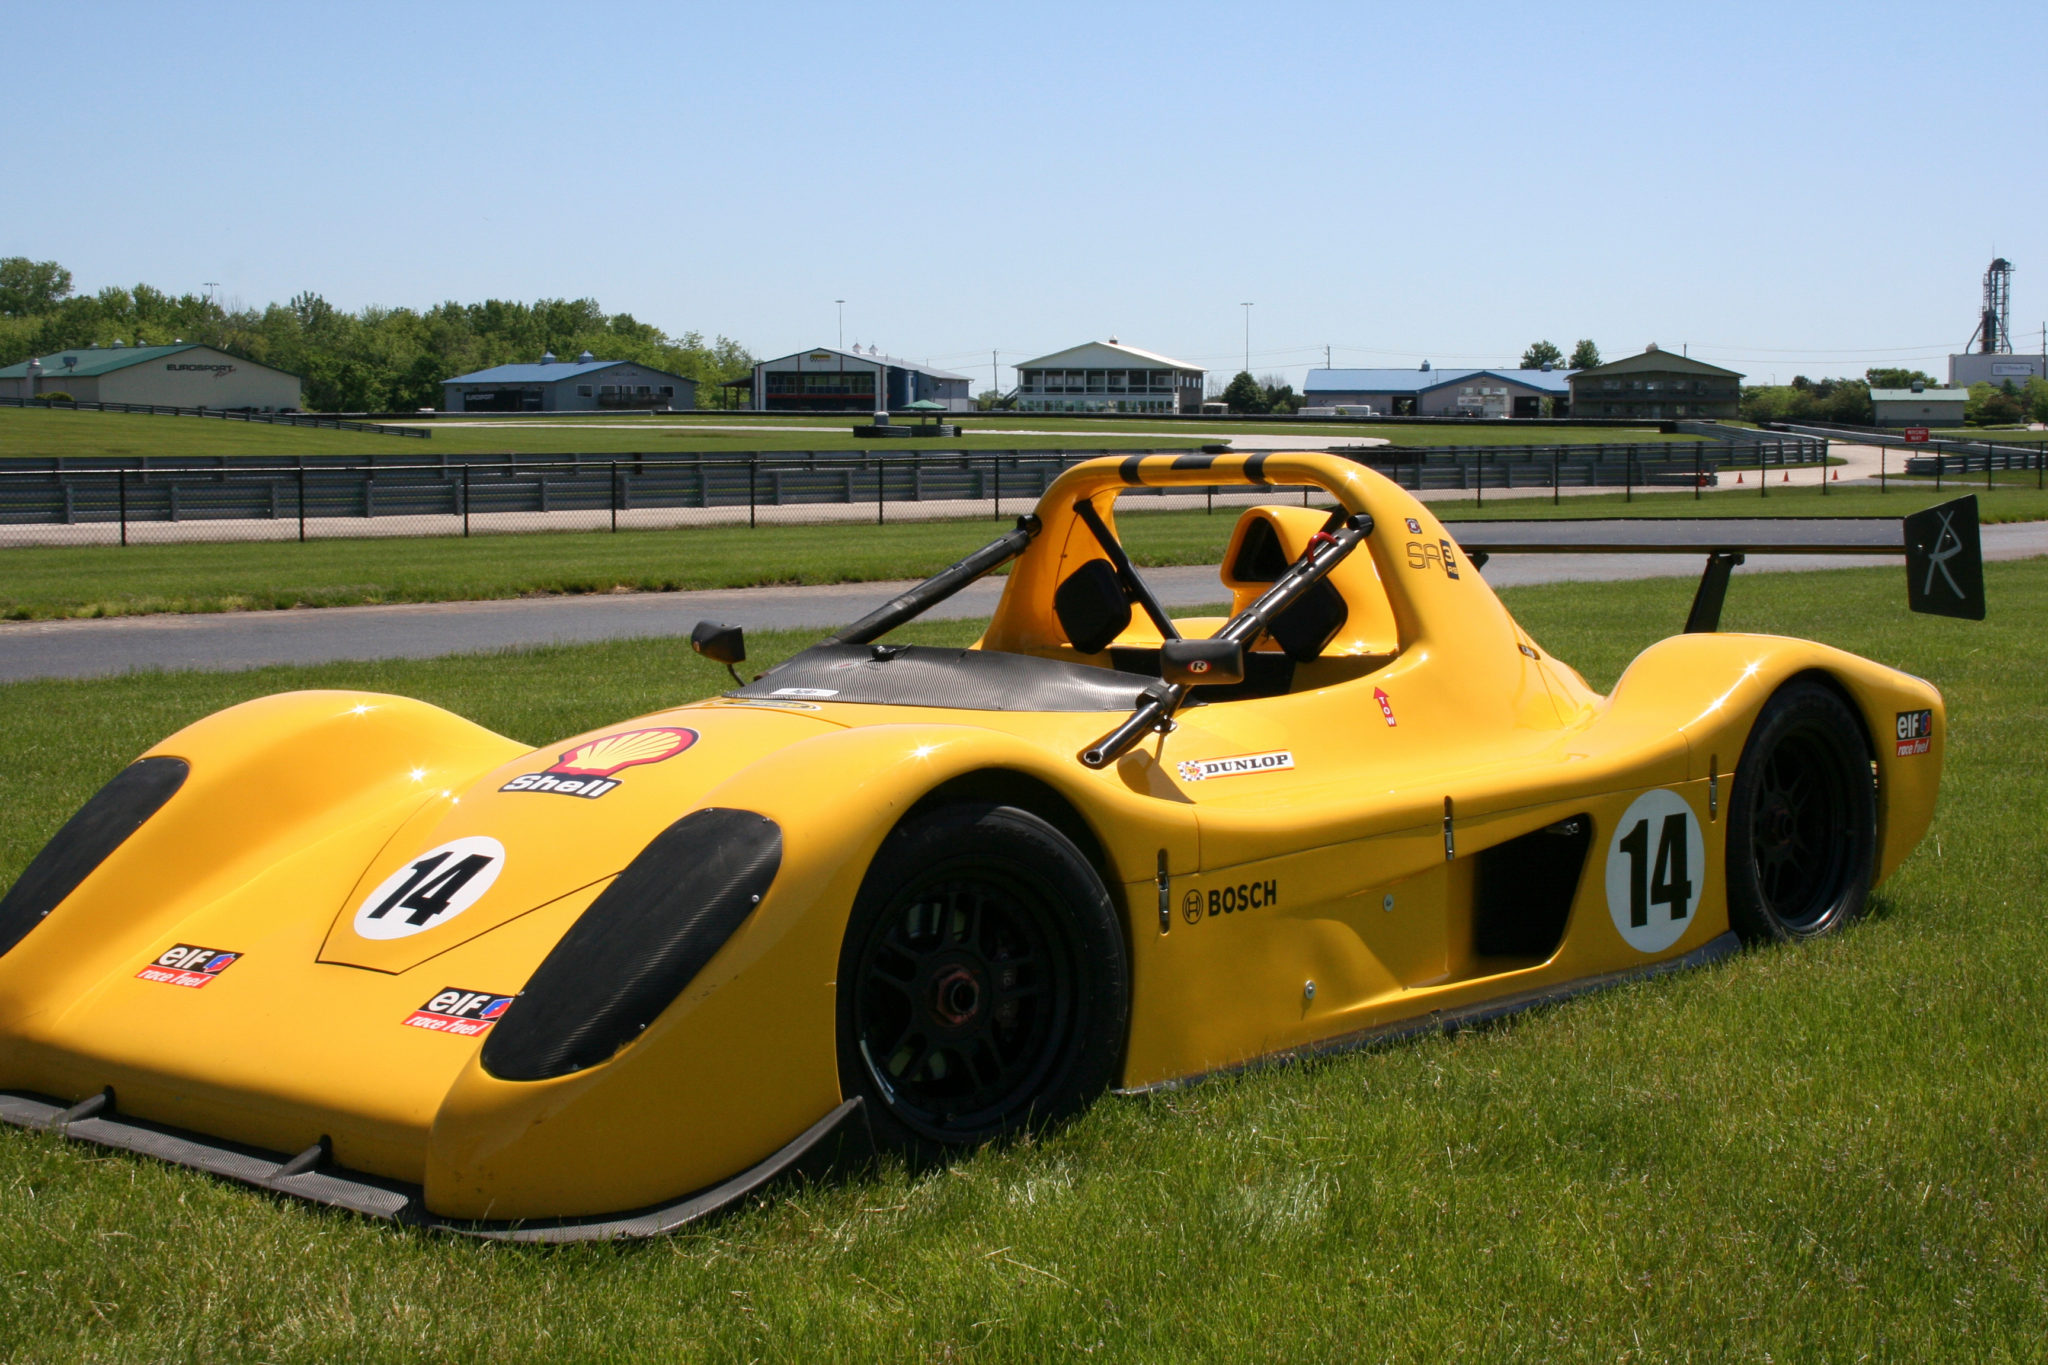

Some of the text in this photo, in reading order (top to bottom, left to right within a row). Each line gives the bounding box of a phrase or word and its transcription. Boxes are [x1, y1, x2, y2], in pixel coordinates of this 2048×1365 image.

[1378, 696, 1396, 726] TOW
[1897, 713, 1920, 739] elf
[1897, 738, 1930, 756] race fuel
[1204, 754, 1289, 774] DUNLOP
[502, 774, 617, 798] Shell
[1619, 812, 1692, 929] 14
[366, 851, 496, 927] 14
[1208, 879, 1277, 917] BOSCH
[158, 946, 217, 970] elf
[136, 969, 214, 988] race fuel
[427, 991, 492, 1017] elf
[404, 1016, 491, 1035] race fuel
